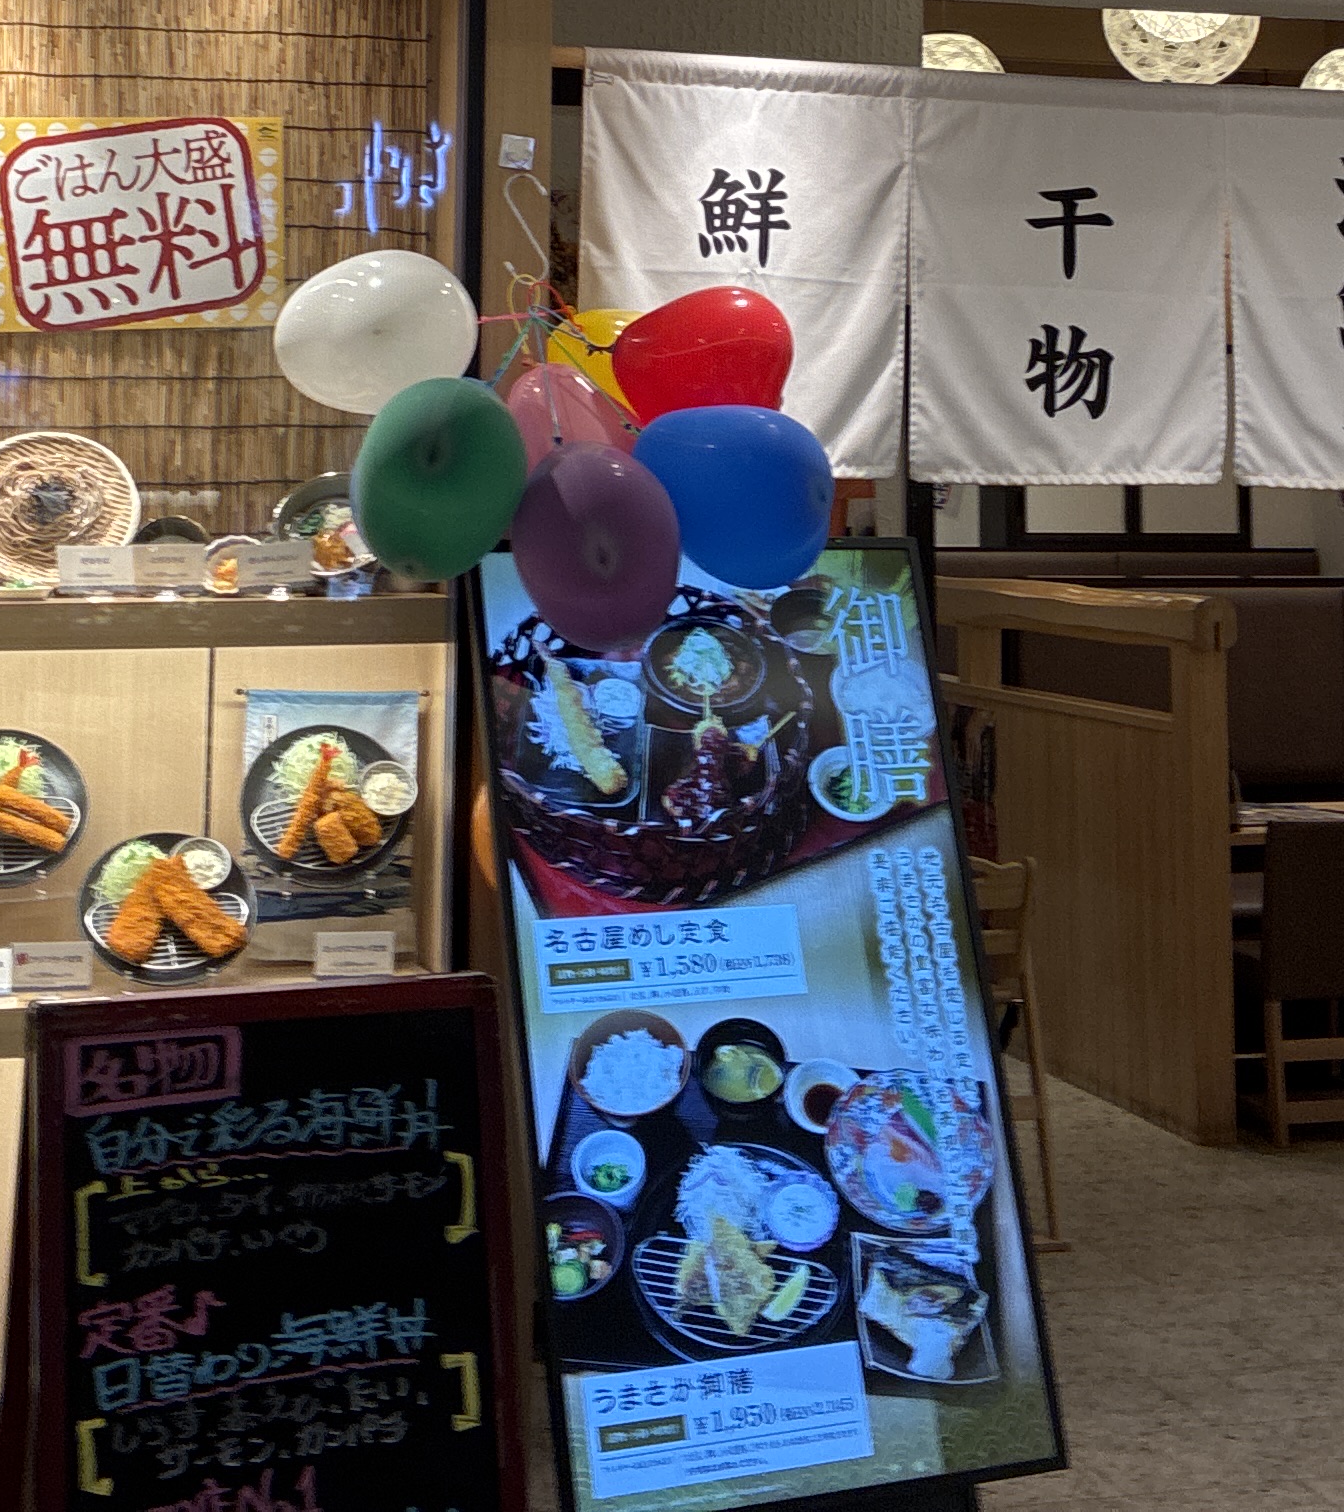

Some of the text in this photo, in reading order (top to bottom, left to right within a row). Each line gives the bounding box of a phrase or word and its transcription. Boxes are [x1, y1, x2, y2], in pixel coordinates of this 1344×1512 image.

[11, 128, 235, 206] ごはん大盛
[20, 182, 258, 322] 無料
[1022, 185, 1115, 421] 干物
[824, 585, 933, 805] 御膳
[543, 916, 733, 955] 名古屋めし定食
